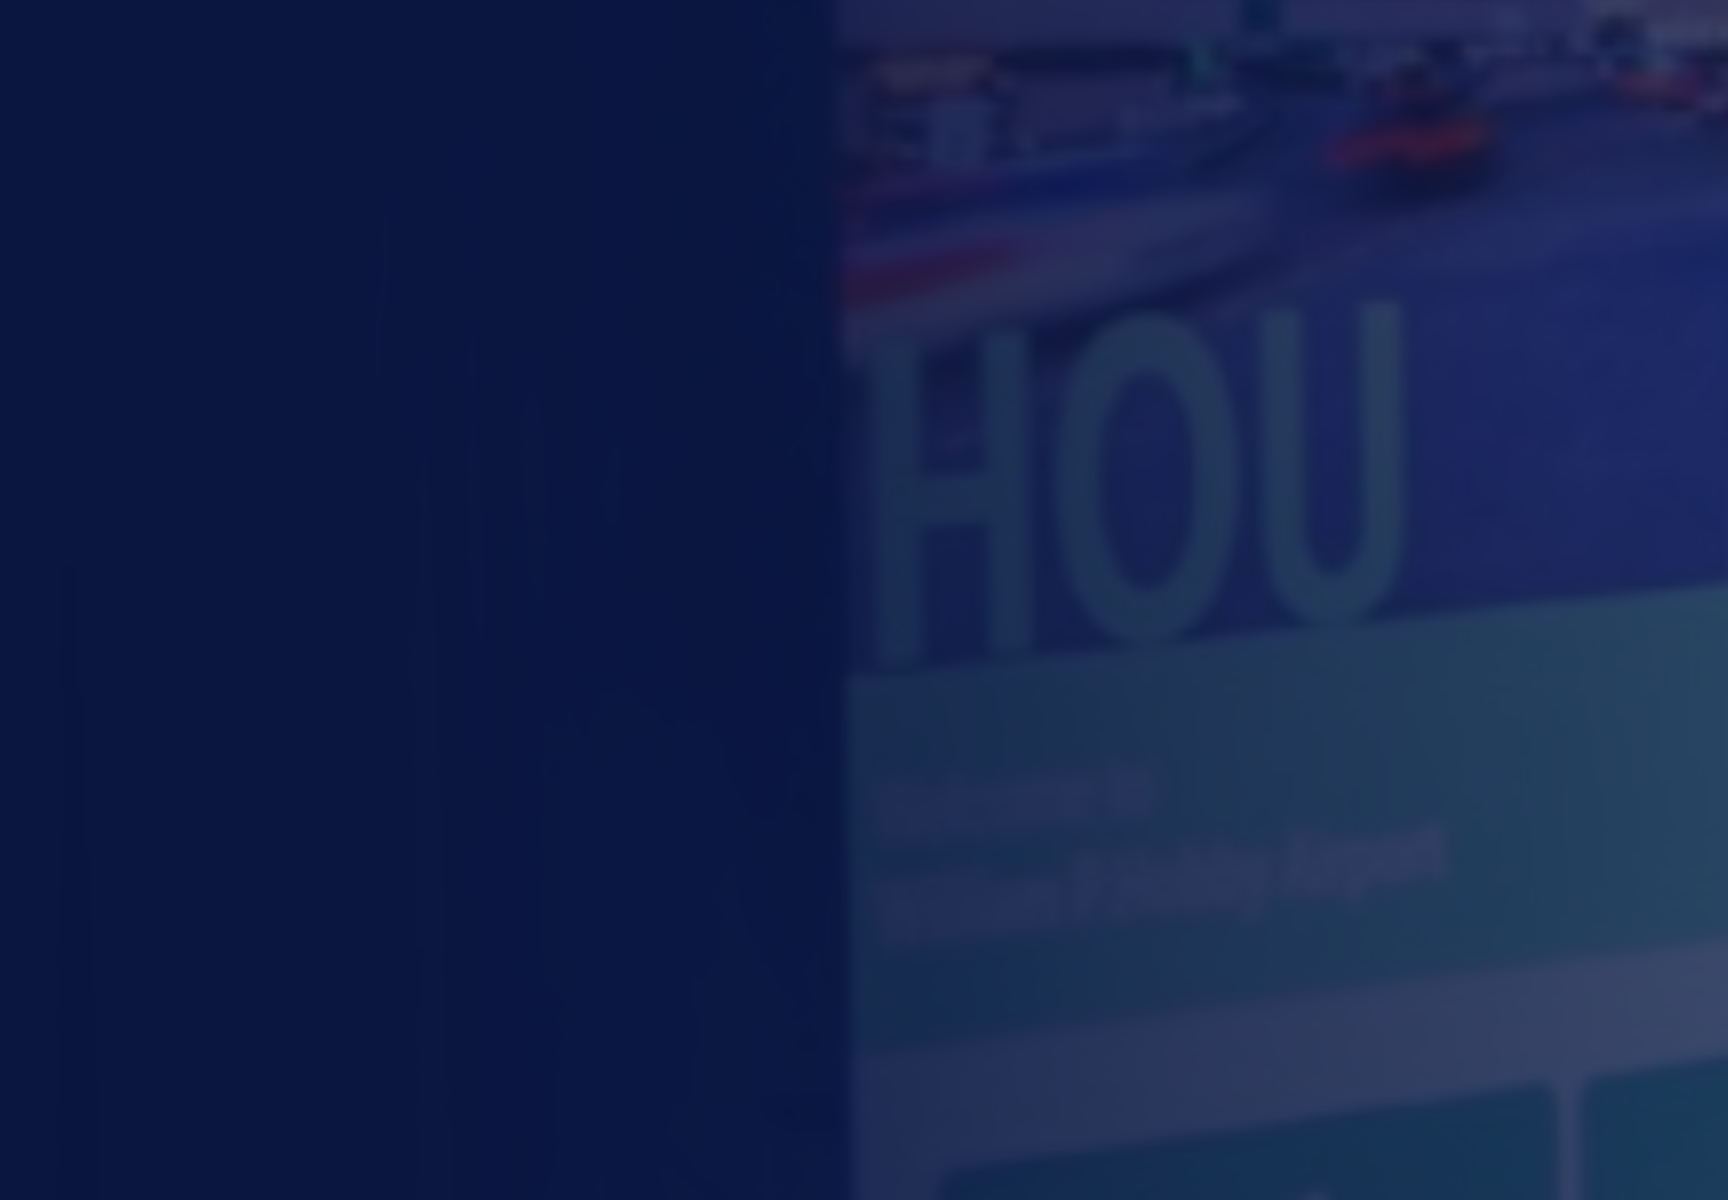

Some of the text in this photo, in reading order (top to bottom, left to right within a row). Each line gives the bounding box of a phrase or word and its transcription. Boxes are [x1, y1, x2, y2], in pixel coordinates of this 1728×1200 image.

[874, 302, 1406, 668] HOU
[876, 758, 1157, 846] Welcome to
[872, 866, 1062, 948] William
[1113, 840, 1272, 924] Hobby
[1282, 820, 1446, 912] Airport
